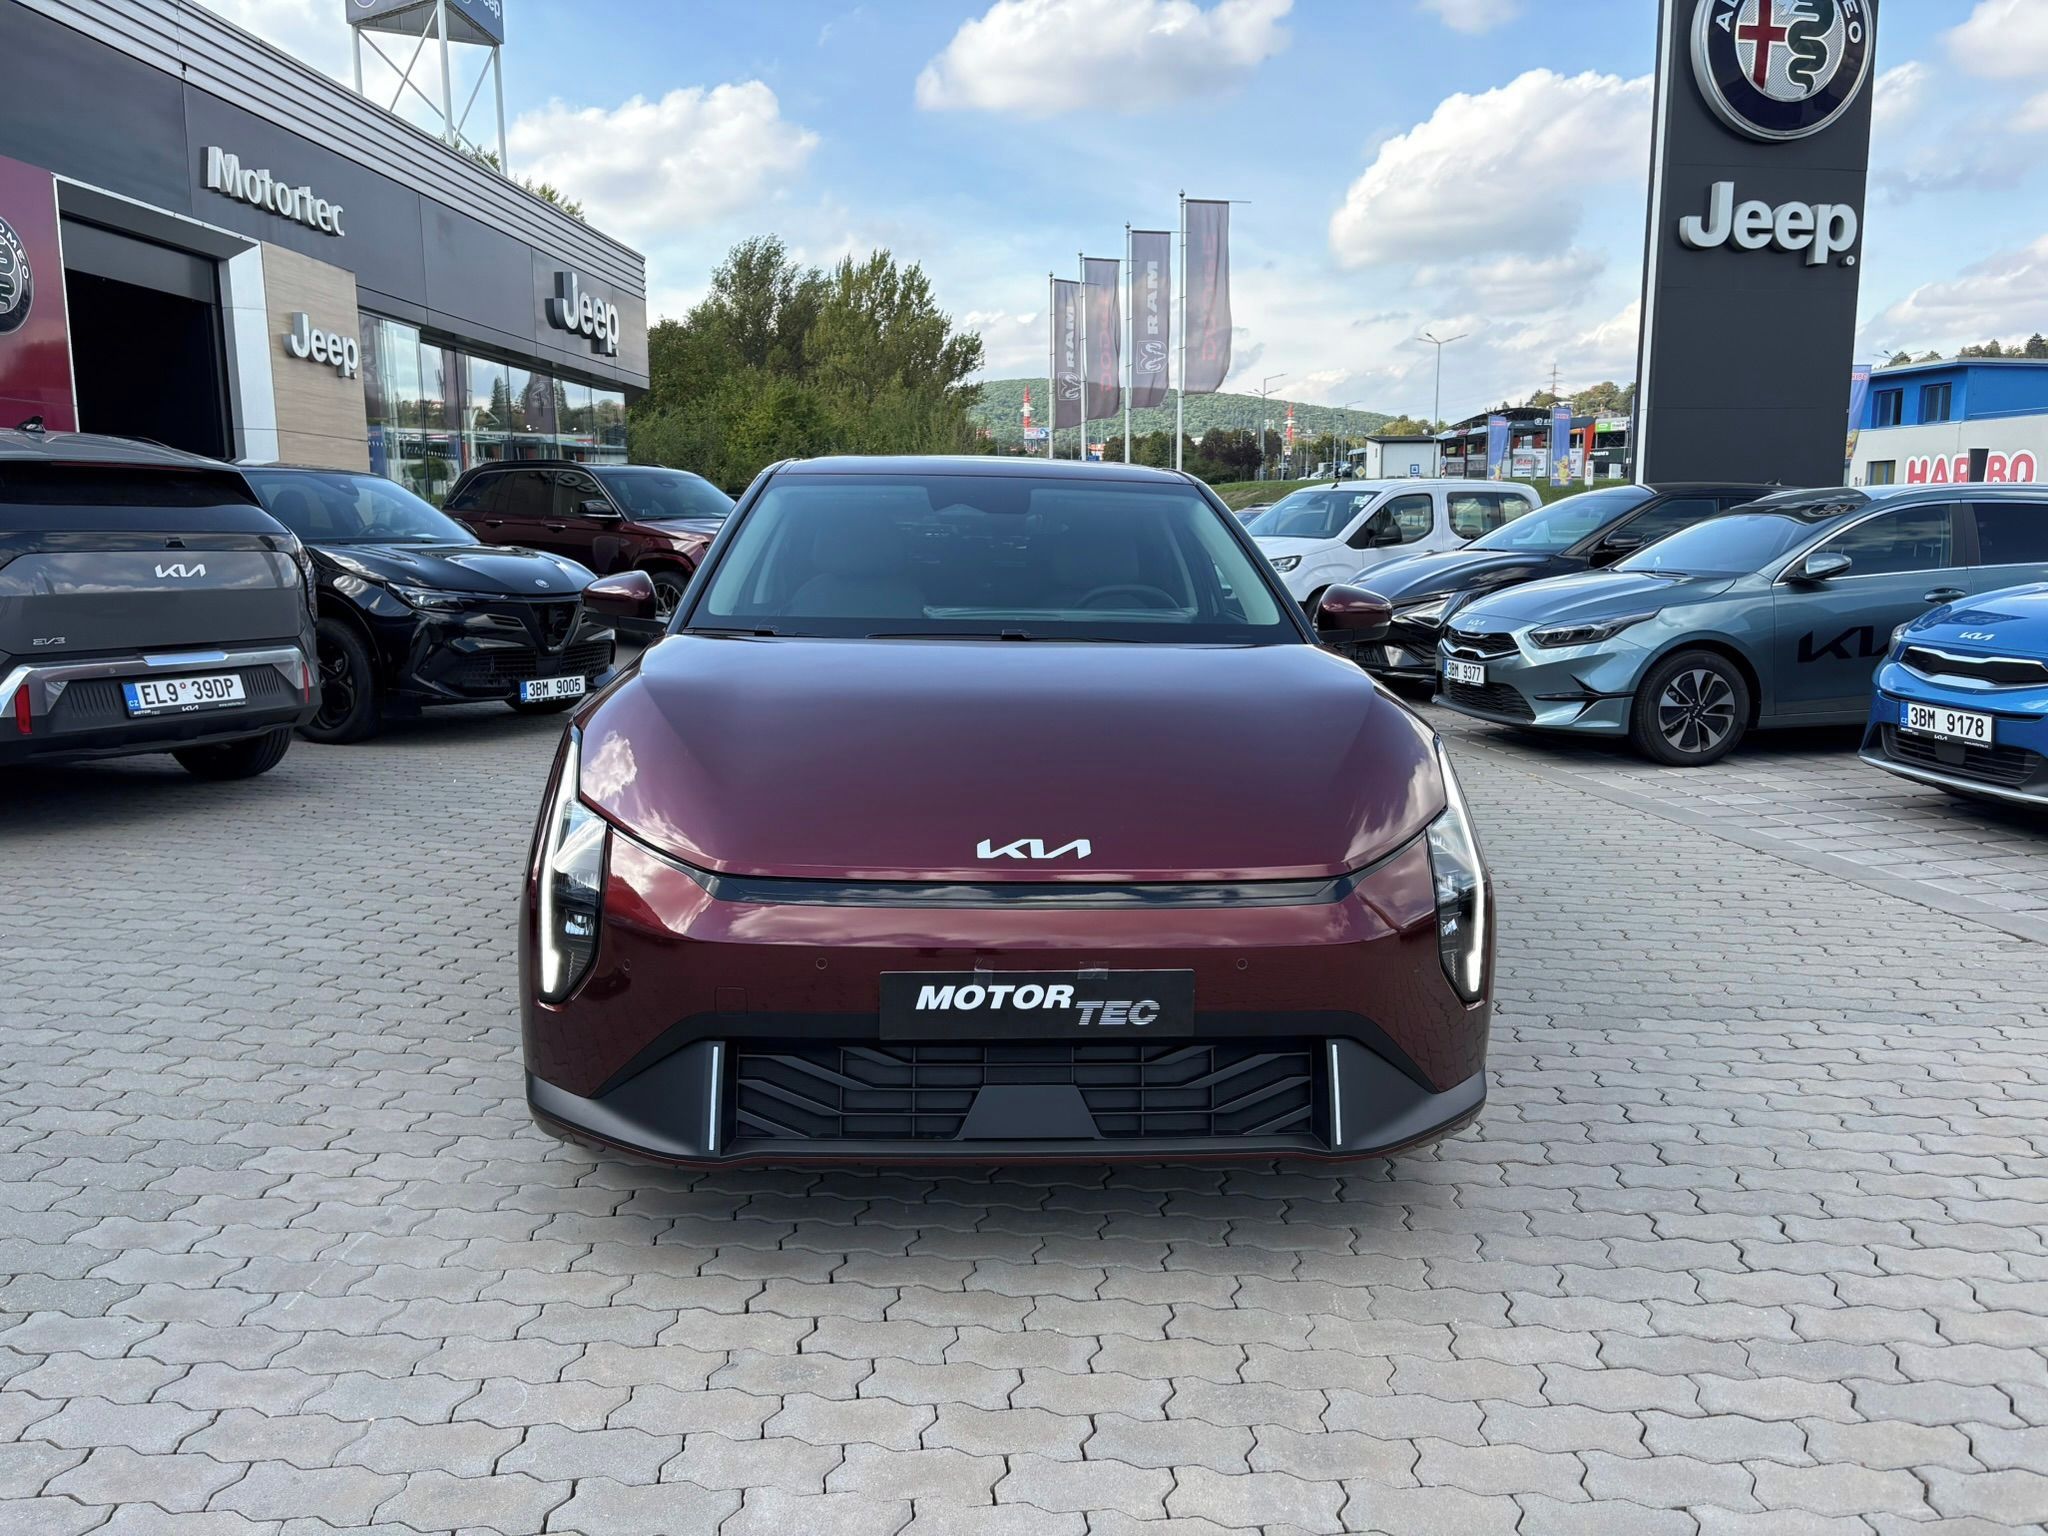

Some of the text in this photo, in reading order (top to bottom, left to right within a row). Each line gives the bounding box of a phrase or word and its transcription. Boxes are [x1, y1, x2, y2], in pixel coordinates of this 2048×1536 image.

[204, 146, 345, 236] Motortec
[1680, 181, 1857, 266] Jeep
[1147, 261, 1158, 334] RAM
[548, 272, 620, 354] Jeep
[286, 312, 359, 377] Jeep
[1066, 306, 1075, 368] RAM
[1905, 451, 2036, 483] HARBO
[155, 564, 206, 578] KIA
[33, 636, 66, 645] EV3
[1959, 632, 1994, 640] KIA
[1447, 660, 1481, 681] 3BM 9377
[141, 678, 234, 705] EL9 39DP
[529, 678, 581, 697] 3BM 9005
[1911, 707, 1984, 738] 3BM 9178
[977, 838, 1091, 859] KIA
[915, 984, 1075, 1010] MOTOR
[1076, 1000, 1160, 1025] TEC
